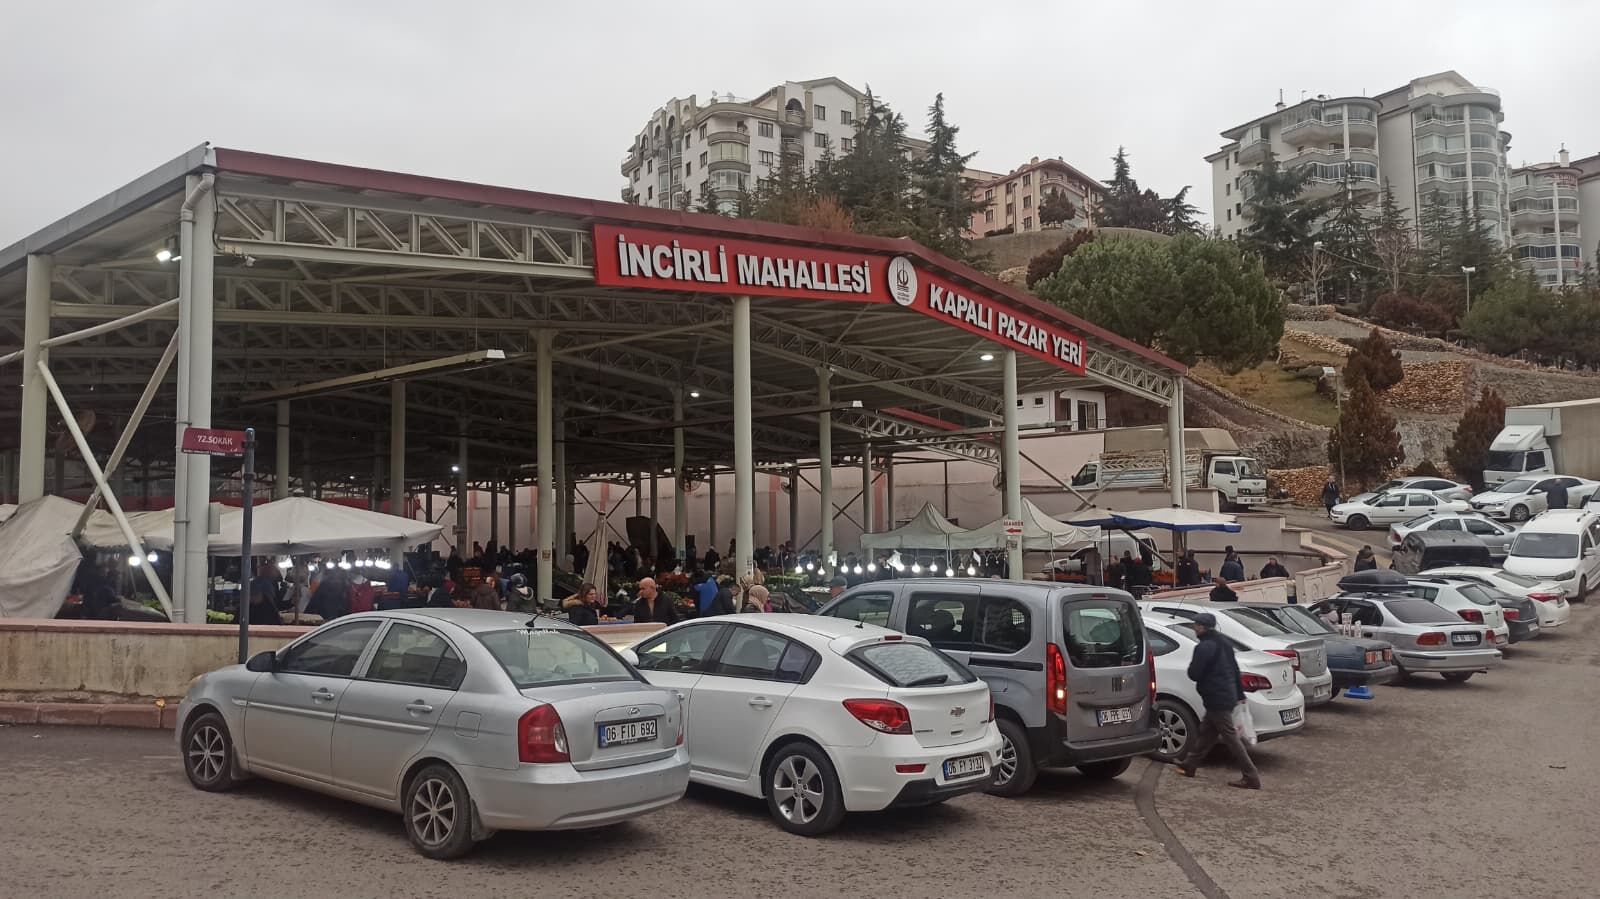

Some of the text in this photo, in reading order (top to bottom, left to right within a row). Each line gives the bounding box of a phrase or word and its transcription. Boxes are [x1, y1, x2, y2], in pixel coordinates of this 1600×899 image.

[618, 233, 872, 294] İNCİRLİ MAHALLESİ
[929, 283, 1084, 367] KAPALI PAZAR YERİ
[606, 727, 617, 741] 06
[640, 721, 655, 736] 692
